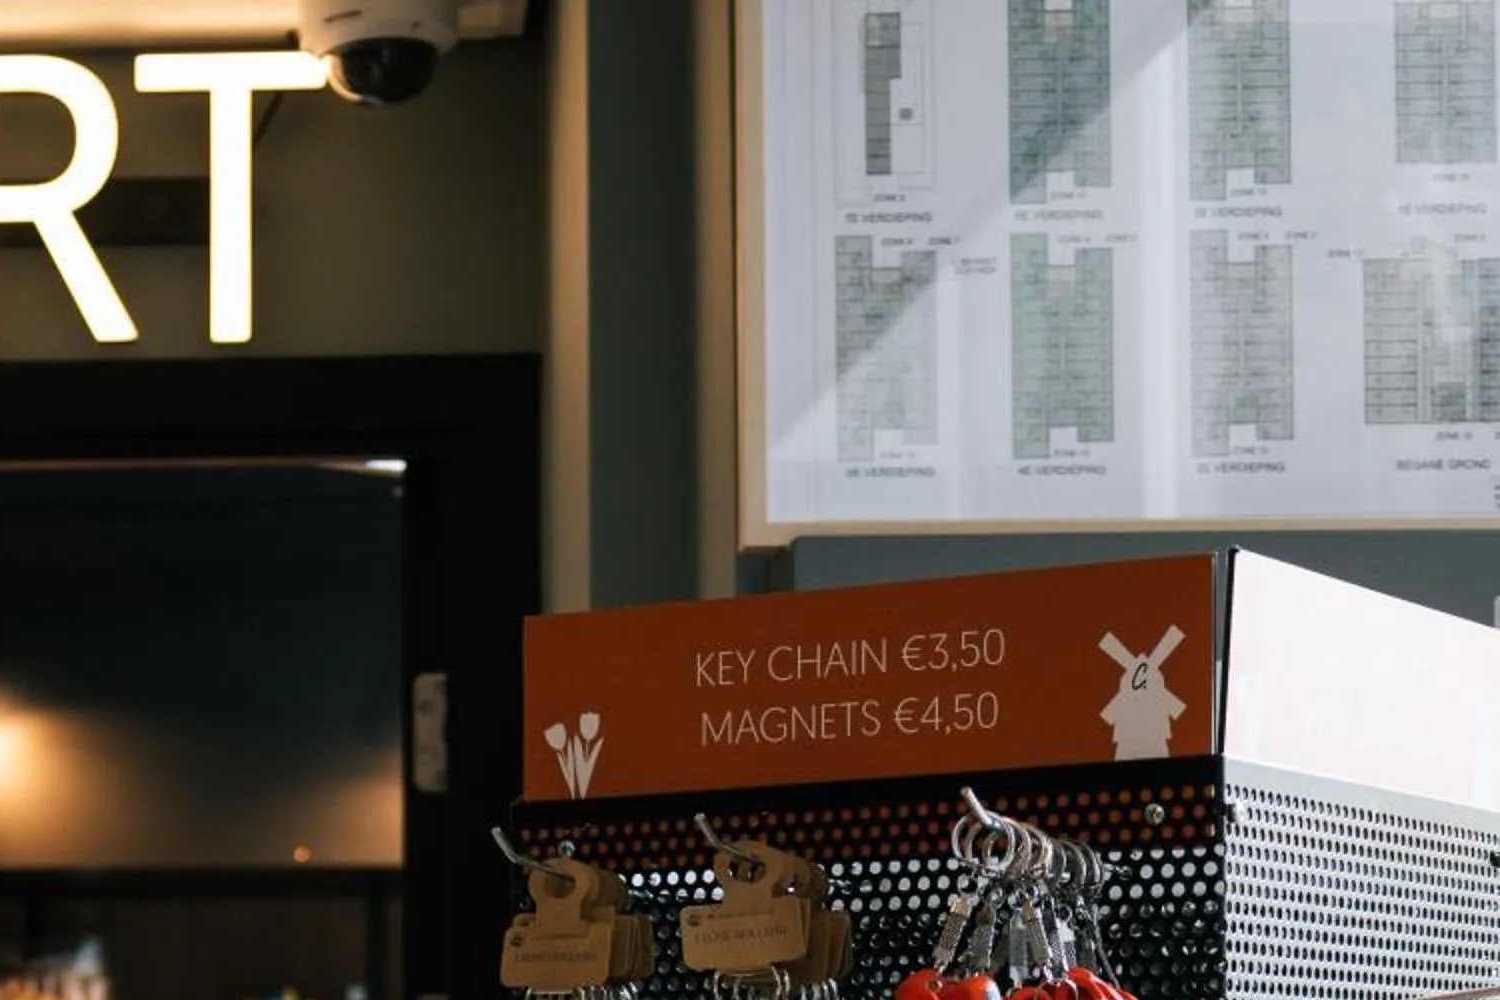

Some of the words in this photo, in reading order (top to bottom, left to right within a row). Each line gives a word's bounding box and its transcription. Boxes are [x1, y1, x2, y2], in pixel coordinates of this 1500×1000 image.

[696, 648, 756, 687] KEY
[767, 637, 888, 682] CHAIN
[900, 627, 1006, 673] €3,50
[701, 699, 882, 747] MAGNETS
[893, 690, 1000, 736] €4,50
